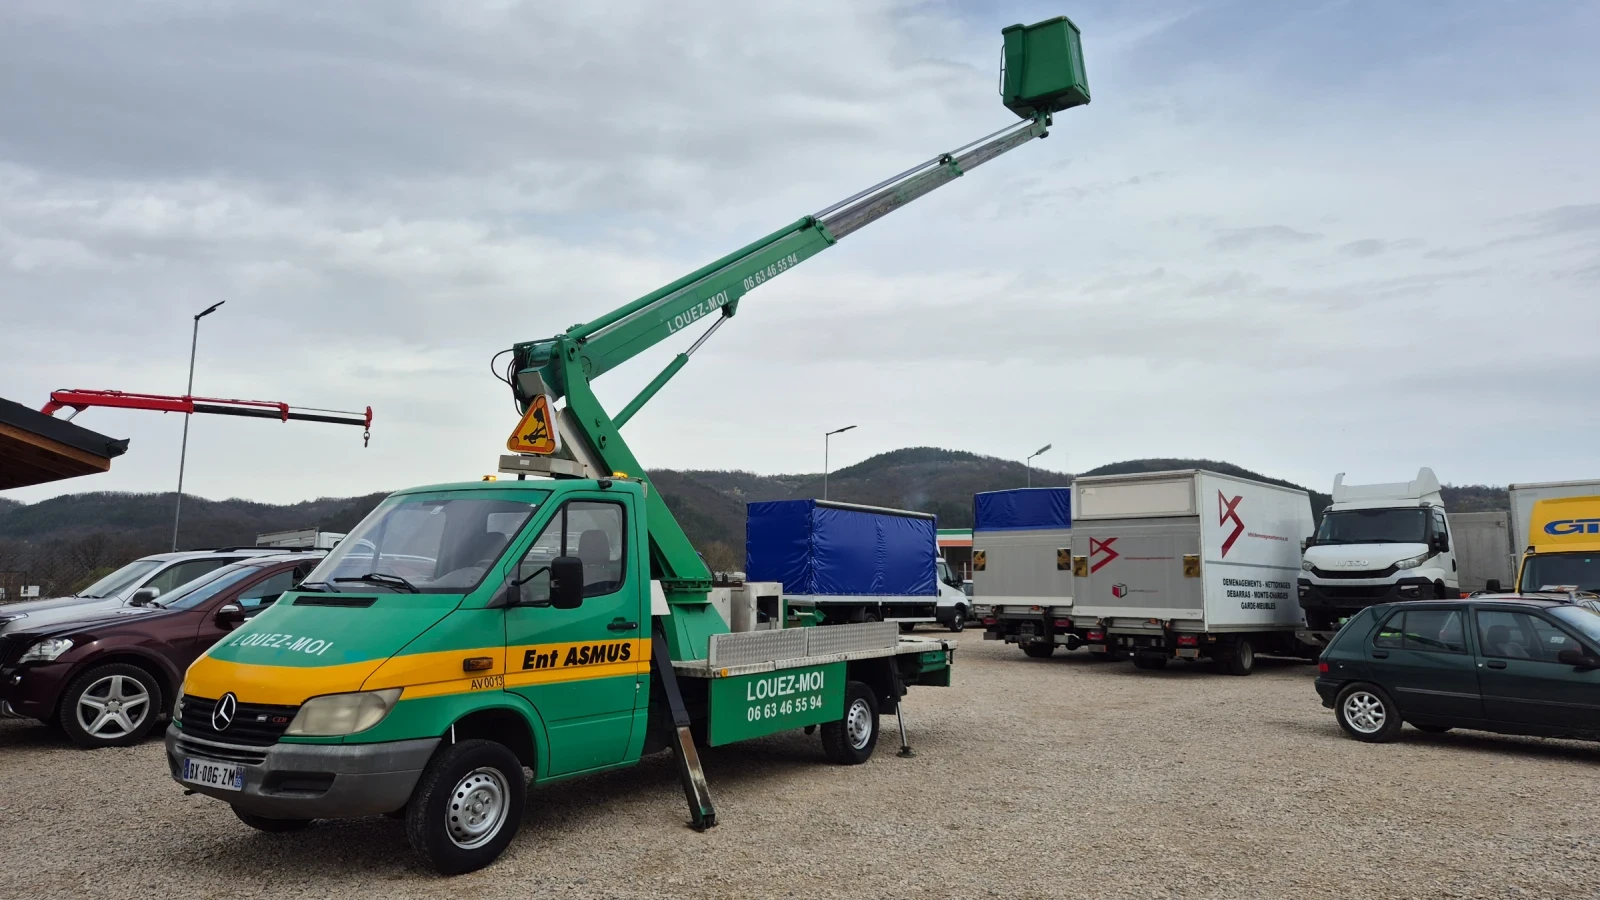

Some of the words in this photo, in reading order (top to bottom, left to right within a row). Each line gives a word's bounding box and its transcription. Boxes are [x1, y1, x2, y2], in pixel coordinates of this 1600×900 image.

[743, 275, 754, 291] 06
[755, 270, 766, 284] 63
[767, 264, 777, 278] 46
[778, 258, 788, 272] 55
[788, 252, 798, 266] 94
[667, 290, 729, 334] LOUEZ-MOI
[1227, 590, 1251, 598] DEBARRAS
[1241, 602, 1276, 610] GARDE-MEUBLES
[230, 633, 334, 656] LOUEZ-MOI
[522, 650, 558, 670] Ent
[564, 642, 632, 666] ASMUS
[747, 671, 824, 701] LOUEZ-MOI
[748, 706, 761, 722] 06
[764, 702, 777, 718] 63
[780, 700, 792, 715] 46
[796, 697, 808, 712] 55
[810, 694, 822, 710] 94
[190, 763, 236, 786] BX-006-ZM
